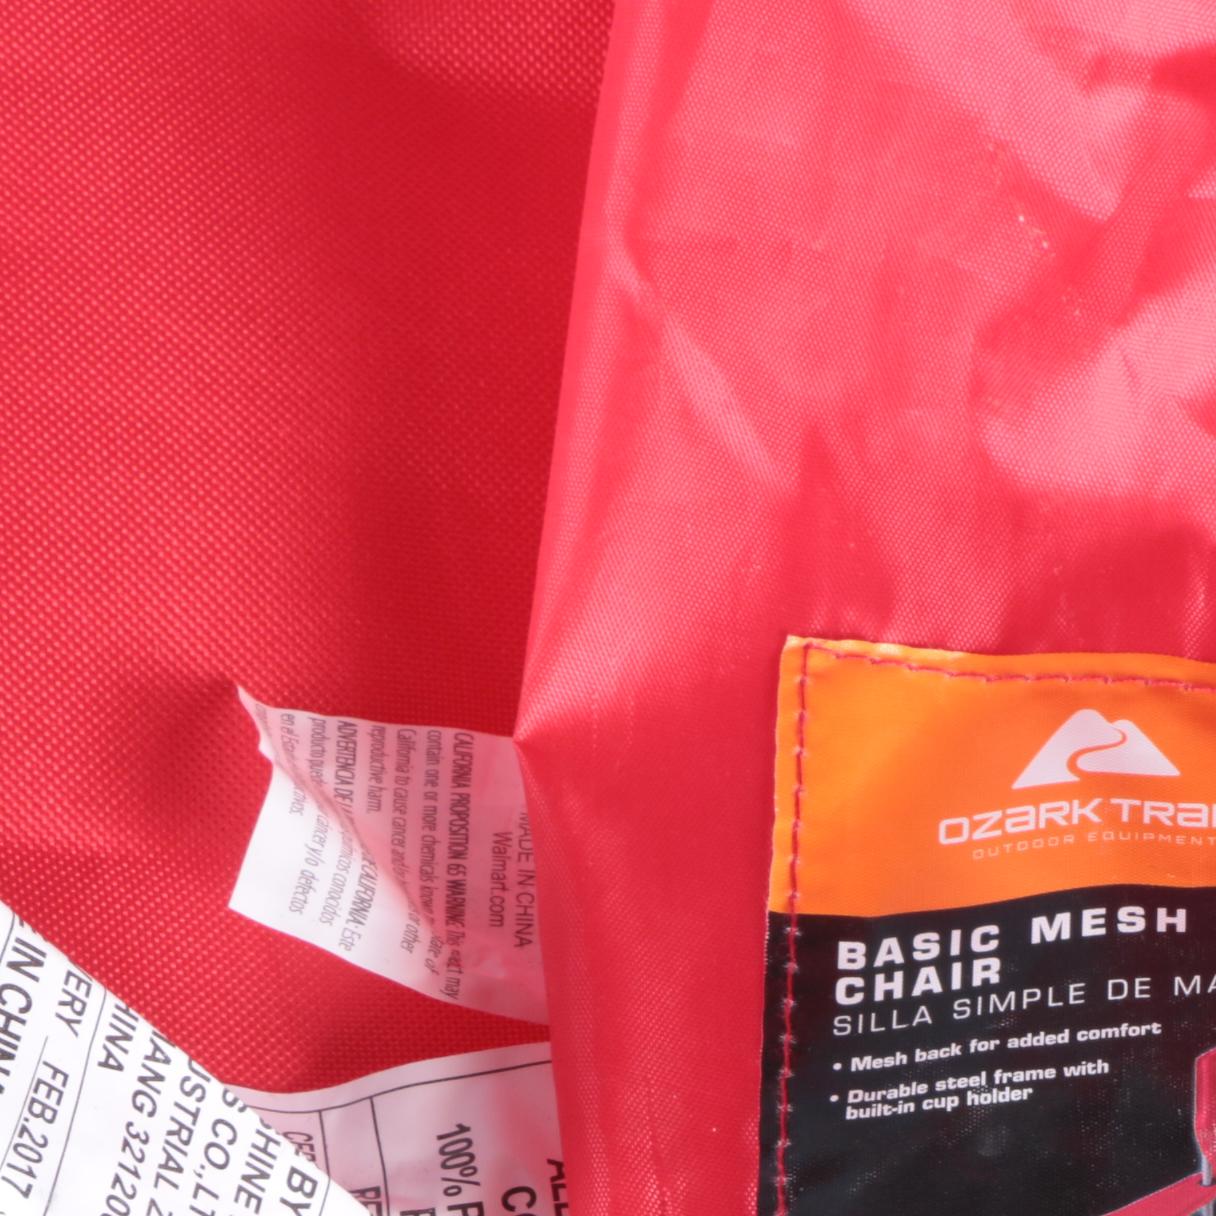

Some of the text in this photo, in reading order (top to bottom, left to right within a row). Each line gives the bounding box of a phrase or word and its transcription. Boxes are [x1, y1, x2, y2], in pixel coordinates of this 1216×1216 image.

[281, 712, 296, 725] en
[308, 716, 331, 757] producto
[334, 720, 358, 785] ADVERTENCIA
[367, 725, 389, 785] reproductive
[396, 728, 417, 774] California
[426, 730, 442, 765] contain
[451, 732, 474, 788] CALIFORNIA
[392, 787, 409, 816] cause
[394, 775, 412, 786] to
[424, 769, 440, 788] one
[424, 791, 439, 803] or
[391, 817, 407, 848] cancer
[422, 805, 438, 831] more
[448, 793, 471, 860] PROPOSITION
[938, 797, 1104, 846] OZARK
[302, 842, 327, 869] y/o
[419, 835, 440, 882] chemicals
[447, 863, 467, 877] 65
[972, 834, 1076, 861] OUTDOOR
[288, 868, 320, 916] defectos
[318, 872, 348, 926] conocidos
[488, 832, 513, 928] Walmart.com
[517, 869, 536, 887] IN
[339, 927, 362, 951] Este
[400, 923, 421, 953] other
[514, 892, 535, 949] CHINA
[836, 905, 1188, 971] BASIC MESH
[6, 936, 48, 983] IN
[834, 957, 1002, 1006] CHAIR
[440, 976, 461, 1000] may
[832, 1006, 934, 1037] SILLA
[952, 982, 1087, 1020] SIMPLE
[1107, 976, 1153, 1001] DE
[850, 1020, 1163, 1073] Mesh back for added comfort
[845, 1085, 1034, 1121] built-in cup holder
[846, 1058, 1110, 1105] Durable steel frame with
[1, 1060, 70, 1199] FEB.2017
[437, 1123, 481, 1198] 100%
